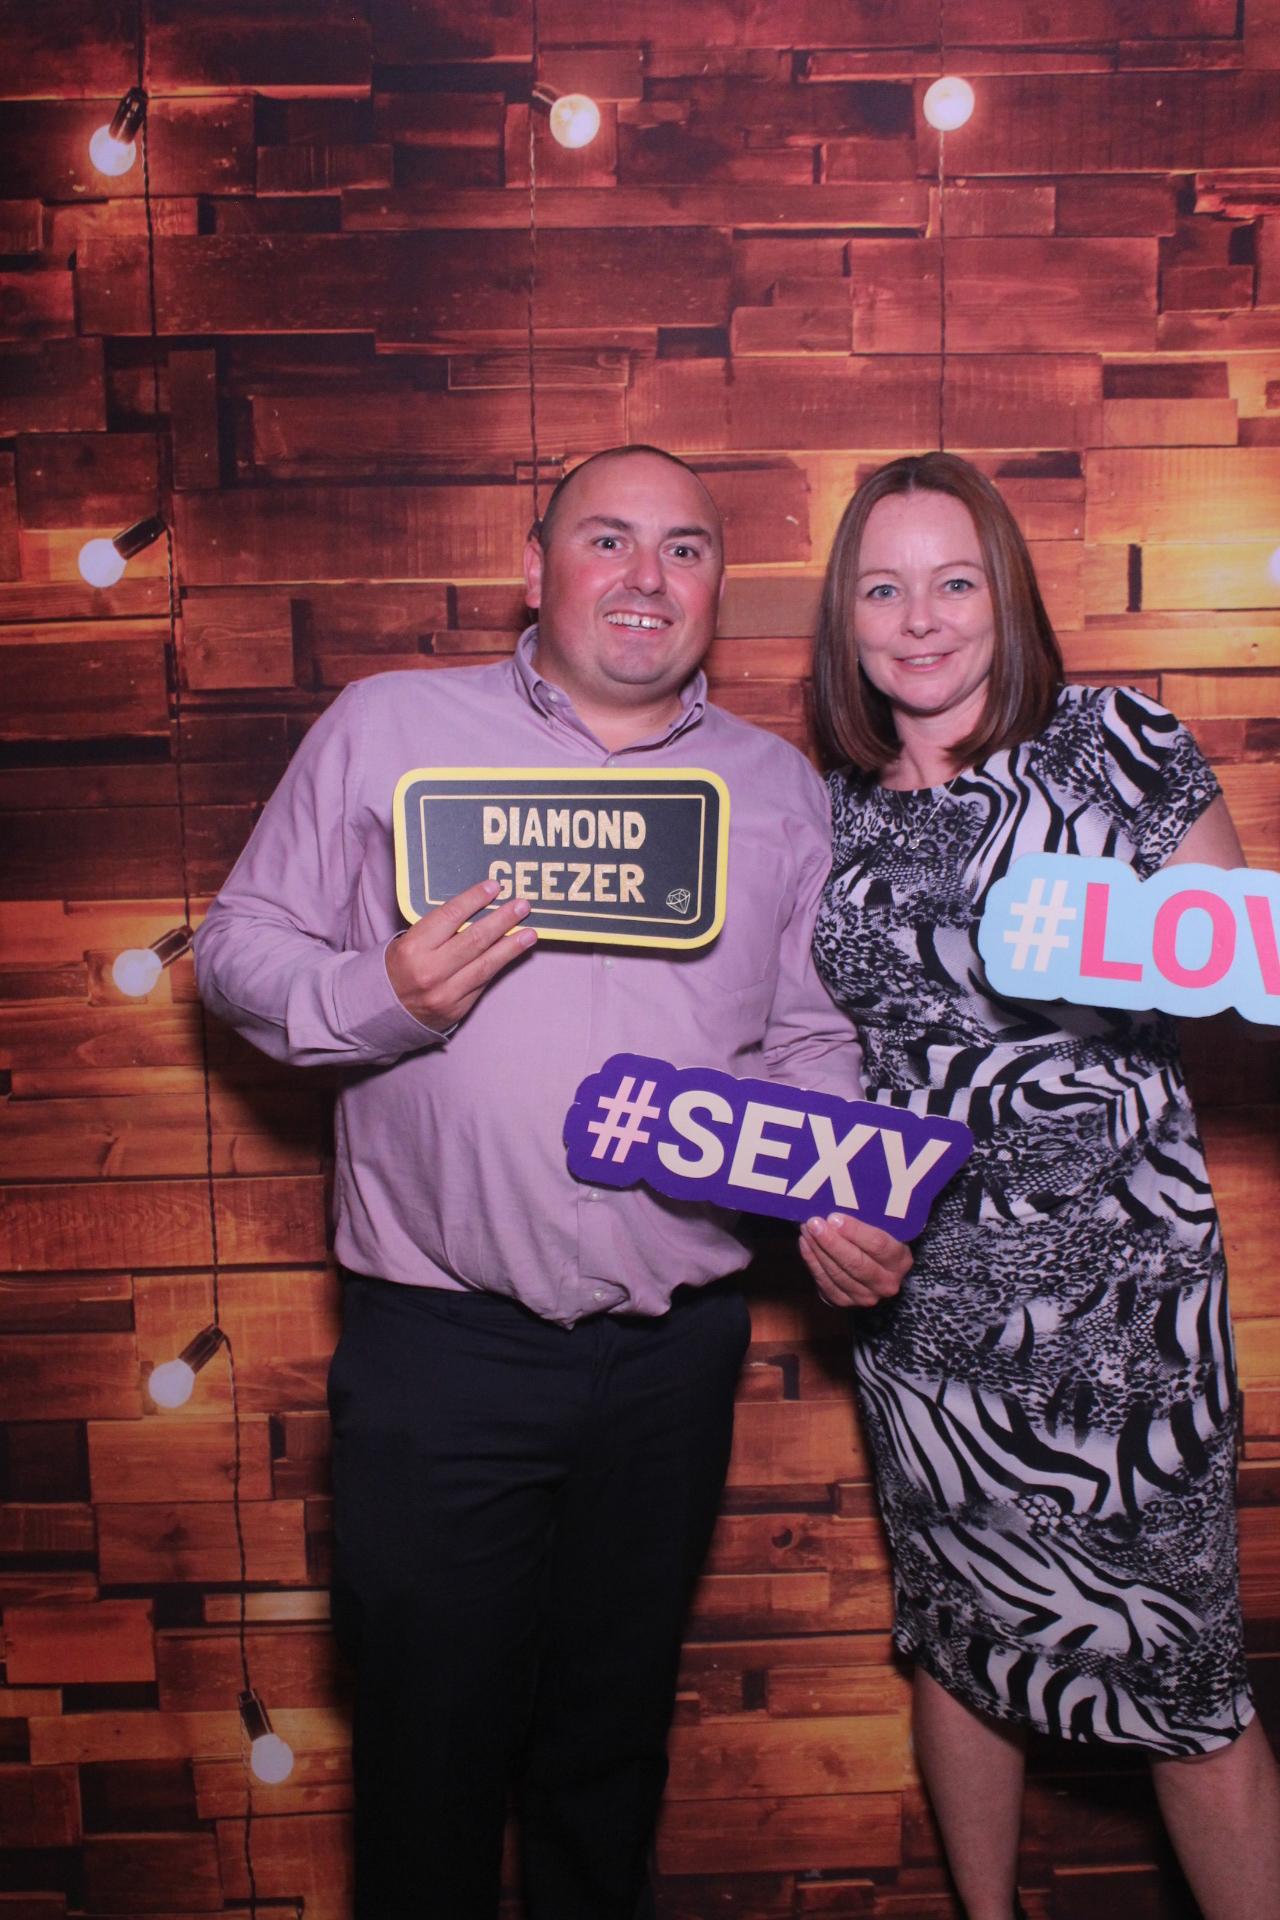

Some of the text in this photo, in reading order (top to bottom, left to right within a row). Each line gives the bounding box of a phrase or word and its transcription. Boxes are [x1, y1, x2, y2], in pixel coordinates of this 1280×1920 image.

[483, 806, 646, 849] DIAMOND
[488, 860, 645, 904] GEEZER
[587, 1076, 952, 1219] #SEXY
